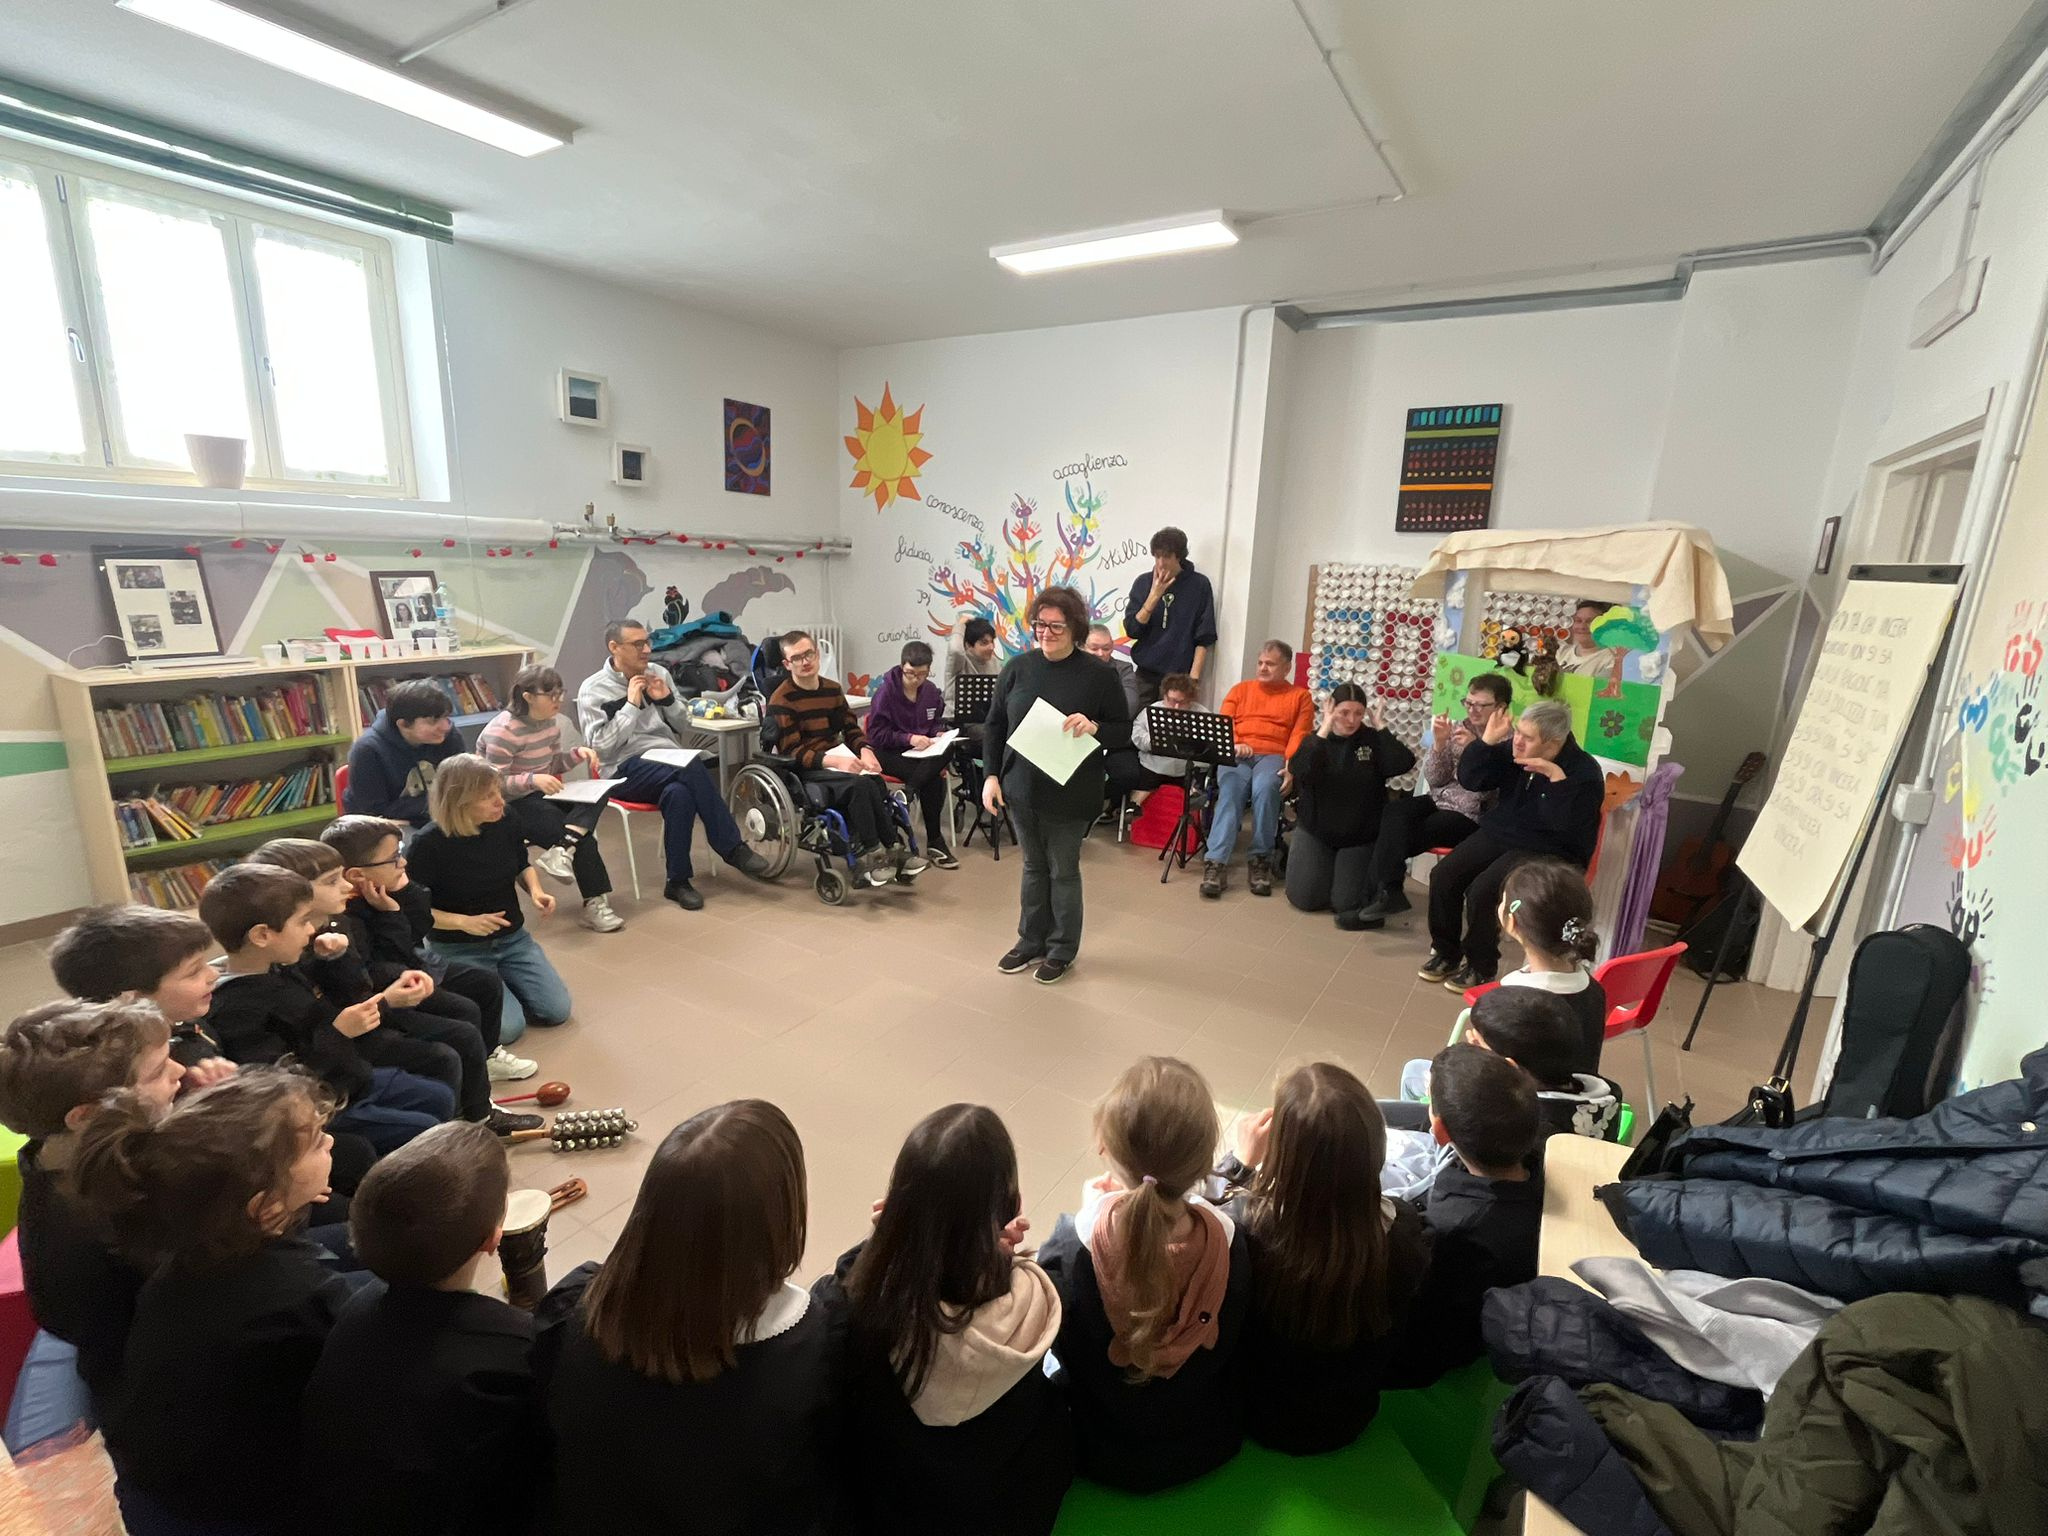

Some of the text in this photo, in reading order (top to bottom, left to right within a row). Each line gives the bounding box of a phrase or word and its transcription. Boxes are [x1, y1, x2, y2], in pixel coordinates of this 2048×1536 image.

[1053, 453, 1128, 480] accoglienza
[926, 494, 984, 533] conoscenza
[895, 535, 934, 564] fiducia
[1097, 538, 1148, 570] skills
